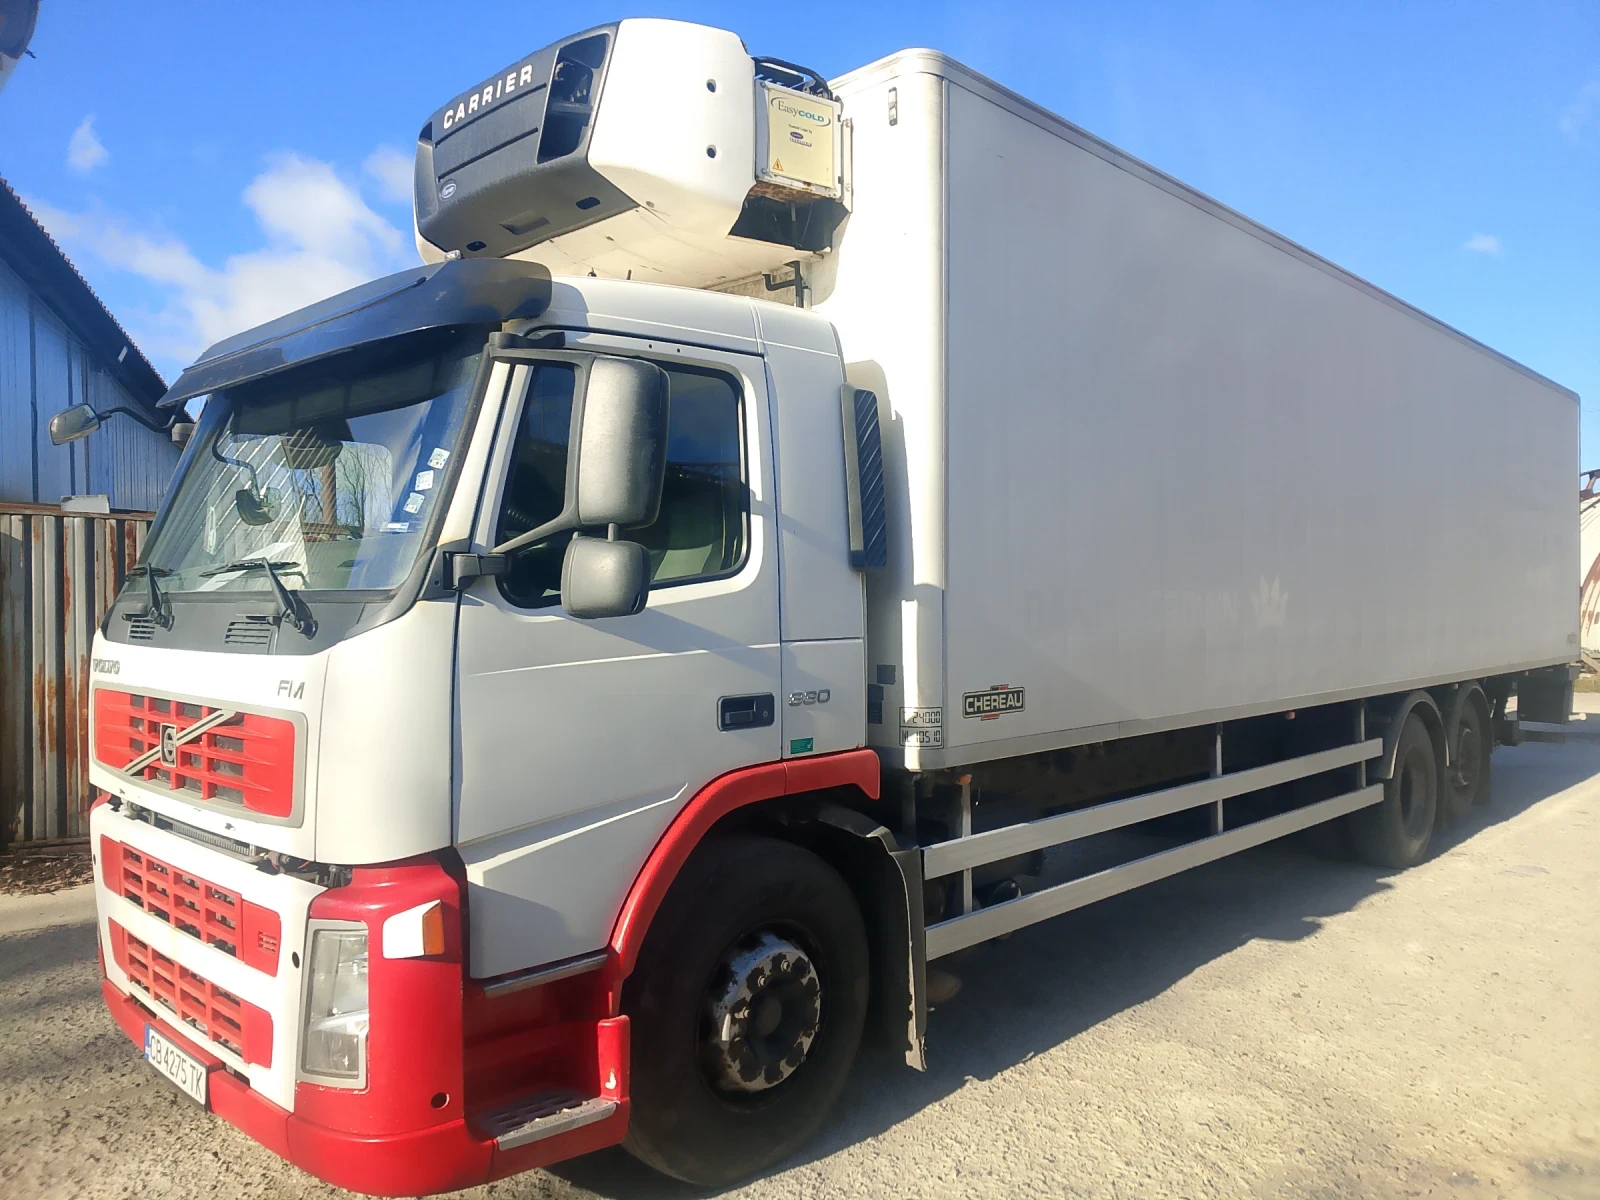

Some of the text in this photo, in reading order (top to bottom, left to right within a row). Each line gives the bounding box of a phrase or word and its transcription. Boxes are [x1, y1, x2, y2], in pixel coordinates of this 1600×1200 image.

[443, 64, 533, 130] CARRIER
[778, 100, 825, 122] EasyCOLD
[277, 680, 305, 700] FM
[965, 692, 1023, 713] CHEREAU
[912, 711, 941, 724] 24000
[150, 1035, 203, 1099] CB 4275 TK
